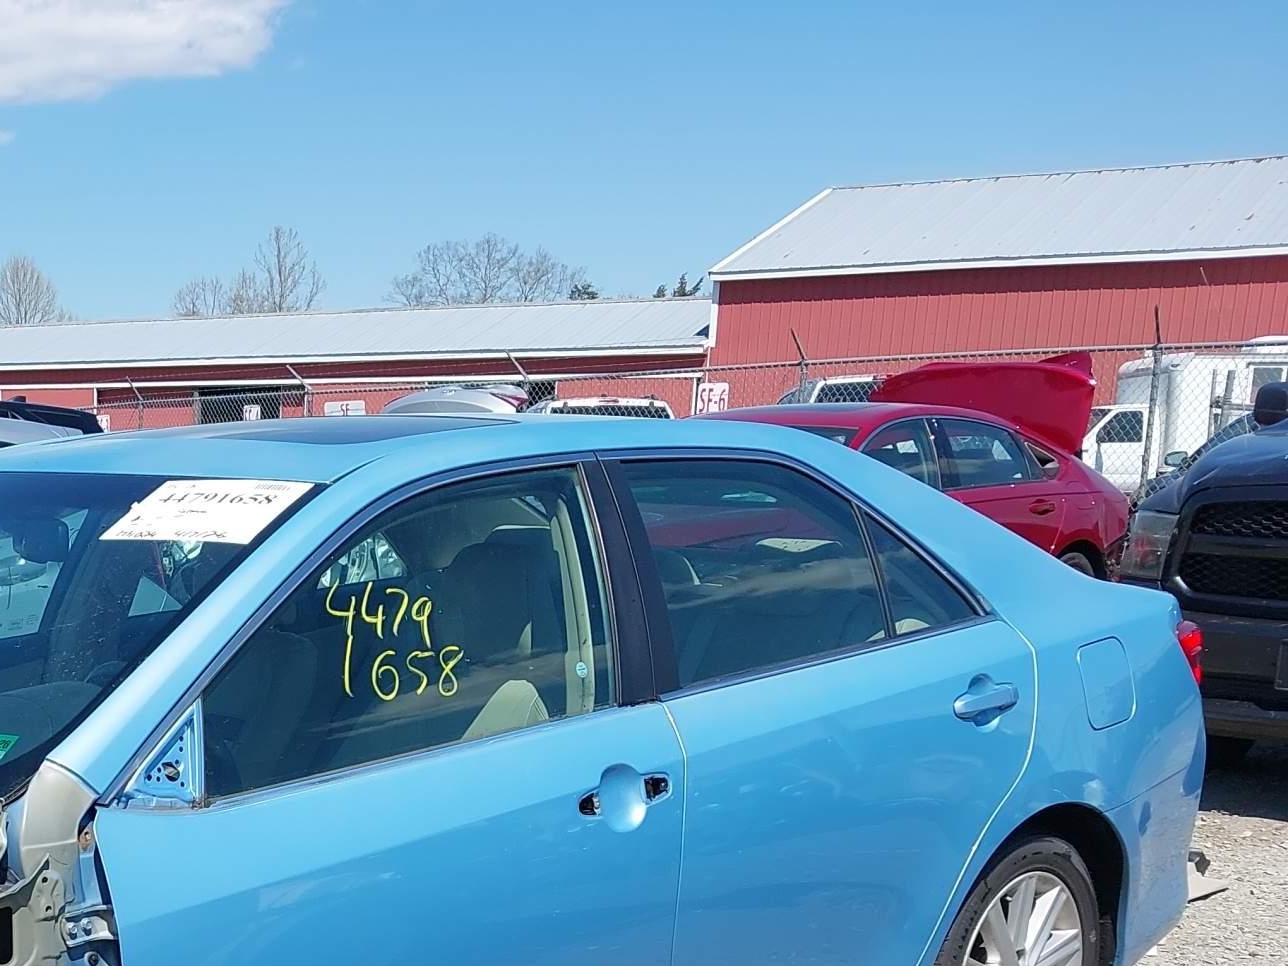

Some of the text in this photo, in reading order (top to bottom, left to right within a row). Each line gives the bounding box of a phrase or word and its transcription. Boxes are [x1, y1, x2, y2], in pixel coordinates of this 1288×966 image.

[699, 388, 727, 413] SF-6
[158, 491, 279, 506] 44791658
[325, 577, 435, 648] 4479
[342, 633, 465, 701] 1658
